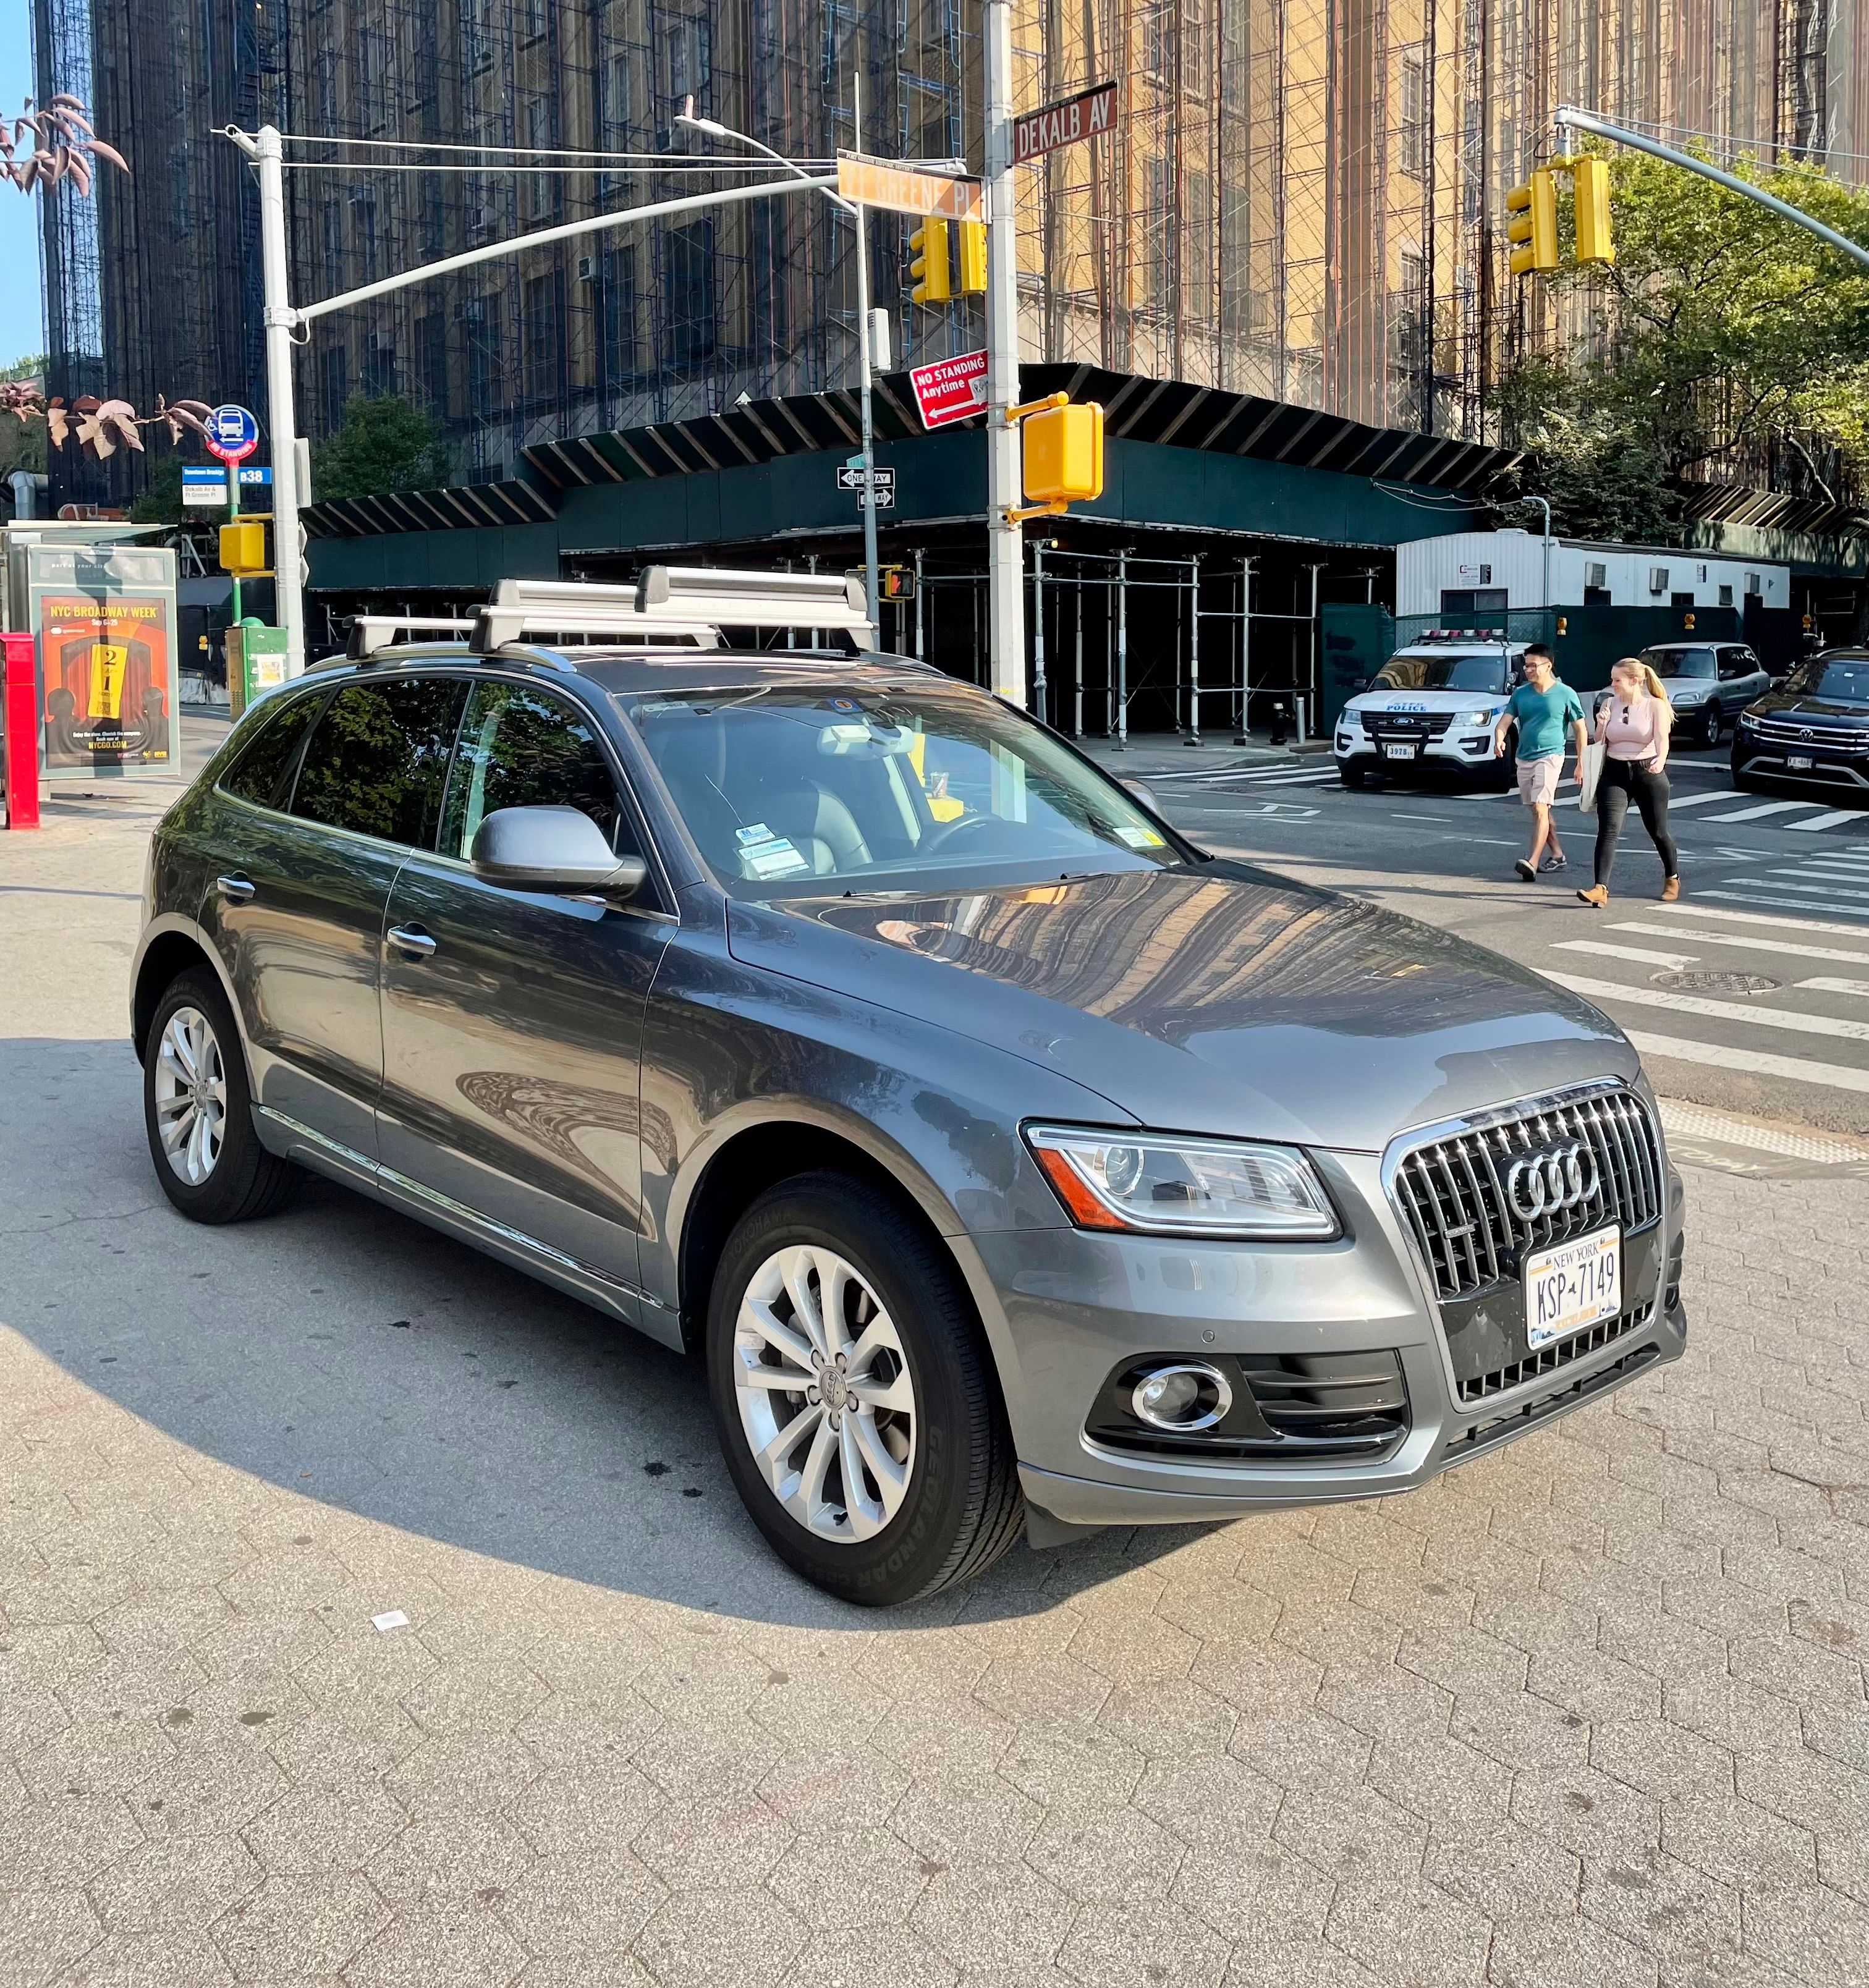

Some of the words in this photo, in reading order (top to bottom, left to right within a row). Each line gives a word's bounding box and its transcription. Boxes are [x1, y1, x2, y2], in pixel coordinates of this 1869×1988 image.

[1019, 104, 1080, 158] DEKALB
[1089, 91, 1109, 133] AV
[877, 171, 944, 214] GREENE
[954, 182, 975, 216] PL
[917, 373, 933, 386] NO
[934, 357, 985, 381] STANDING
[923, 379, 965, 399] Anytime
[210, 441, 220, 452] NO
[219, 442, 253, 457] STANDING
[240, 470, 263, 482] B38
[51, 606, 71, 617] NYC
[74, 606, 129, 618] BROADWAY
[130, 607, 157, 618] WEEK
[104, 650, 116, 666] 2
[104, 676, 110, 690] 1
[88, 741, 127, 749] NYCGO.COM
[1553, 1250, 1574, 1271] NEW
[1576, 1241, 1599, 1262] YORK
[1538, 1272, 1566, 1324] KSP
[1579, 1253, 1614, 1306] 7149
